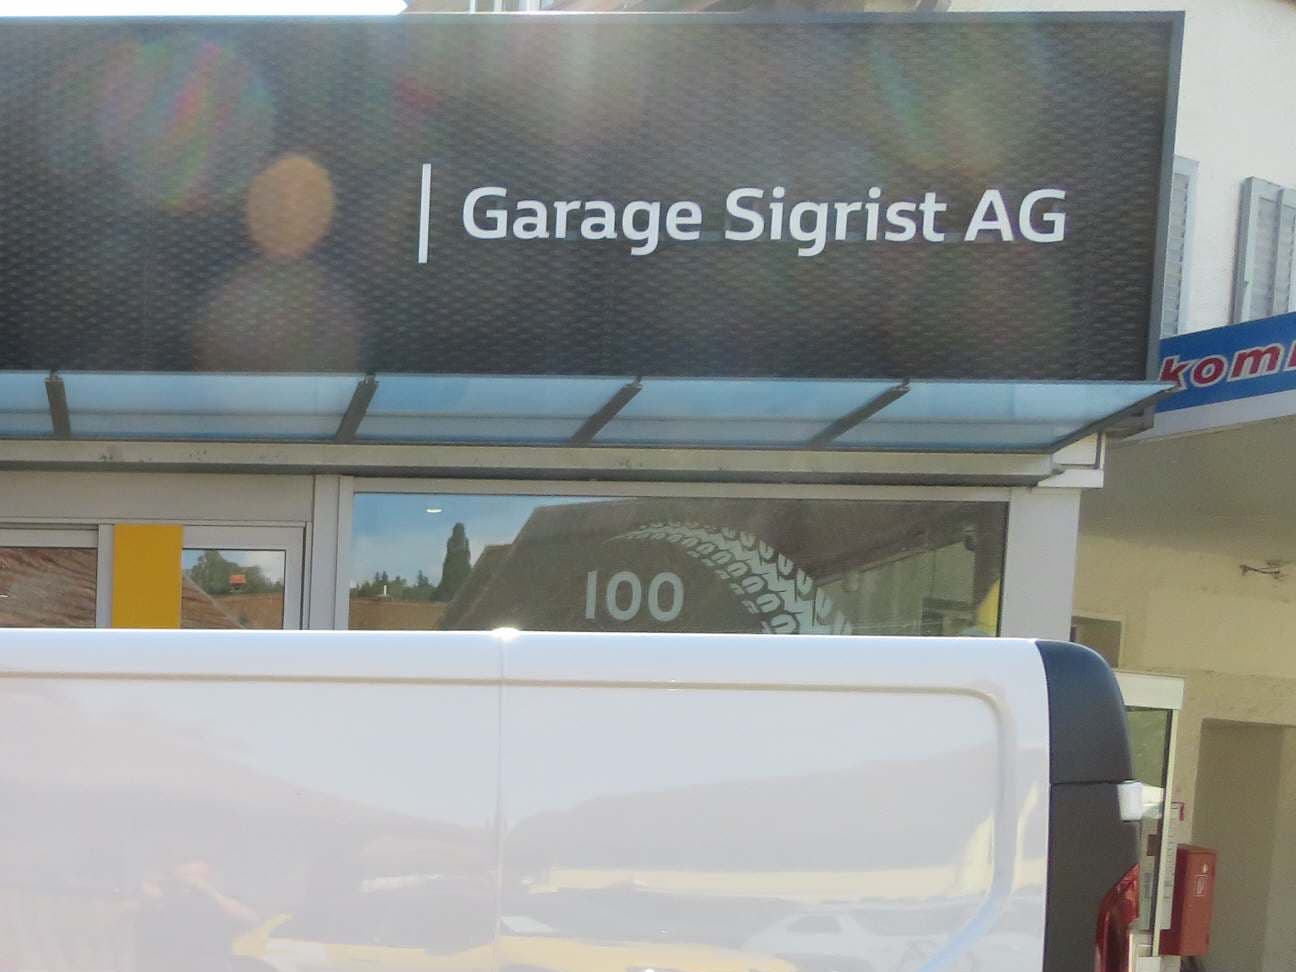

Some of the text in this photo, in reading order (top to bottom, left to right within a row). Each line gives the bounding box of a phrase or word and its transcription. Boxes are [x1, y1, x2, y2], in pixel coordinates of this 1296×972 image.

[461, 186, 1067, 257] Garage Sigrist AG
[585, 570, 684, 622] 100
